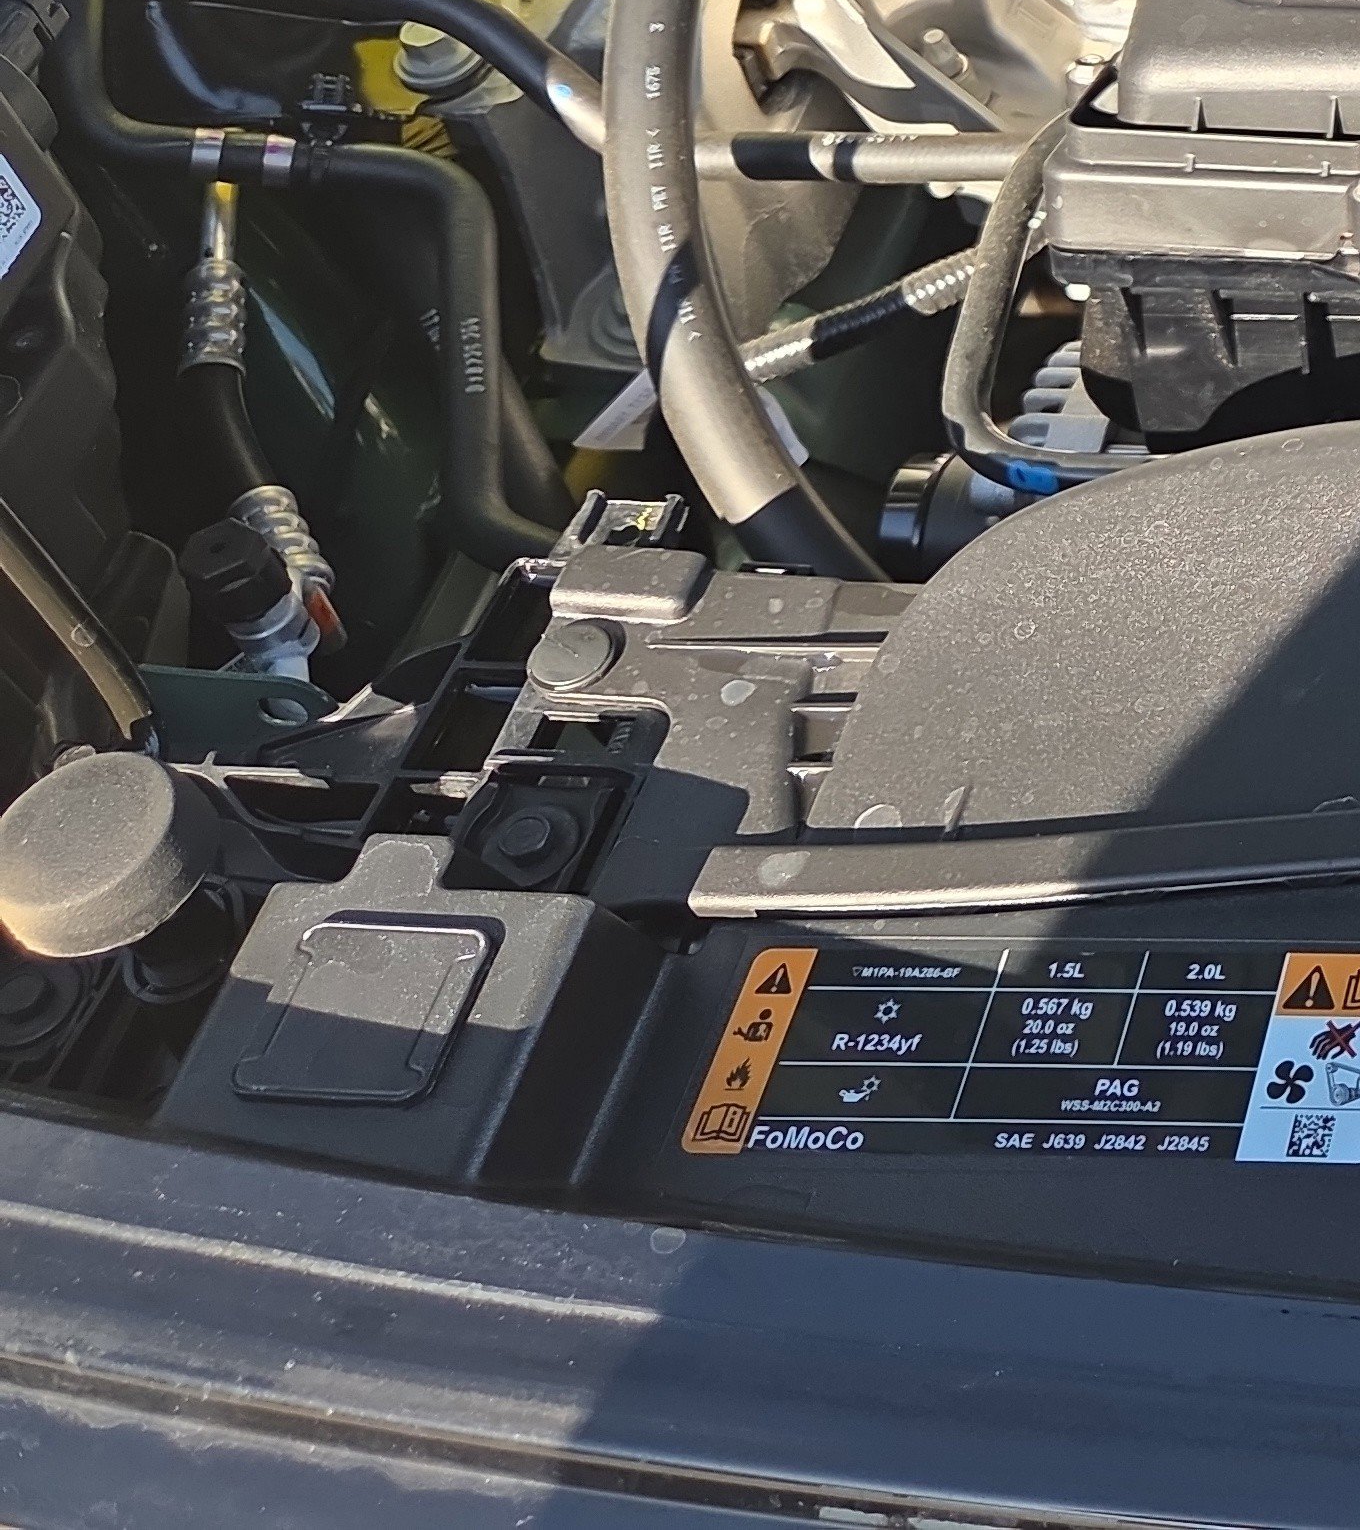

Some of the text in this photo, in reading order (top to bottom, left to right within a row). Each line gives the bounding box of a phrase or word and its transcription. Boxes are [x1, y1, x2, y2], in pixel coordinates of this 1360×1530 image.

[1048, 962, 1085, 979] 1.5L
[1186, 963, 1226, 981] 2.0L
[1021, 997, 1094, 1020] 0.567 kg
[1164, 999, 1238, 1021] 0.539 kg
[1022, 1019, 1076, 1035] 20.0 oz
[1168, 1021, 1220, 1037] 19.0 oz
[831, 1033, 923, 1056] R-1234yf
[1011, 1039, 1079, 1057] (1.25 lbs)
[1156, 1040, 1224, 1060] (1.19 lbs)
[1094, 1078, 1140, 1097] PAG
[747, 1125, 1211, 1152] FoMoCo SAE J639 J2842 J2845
